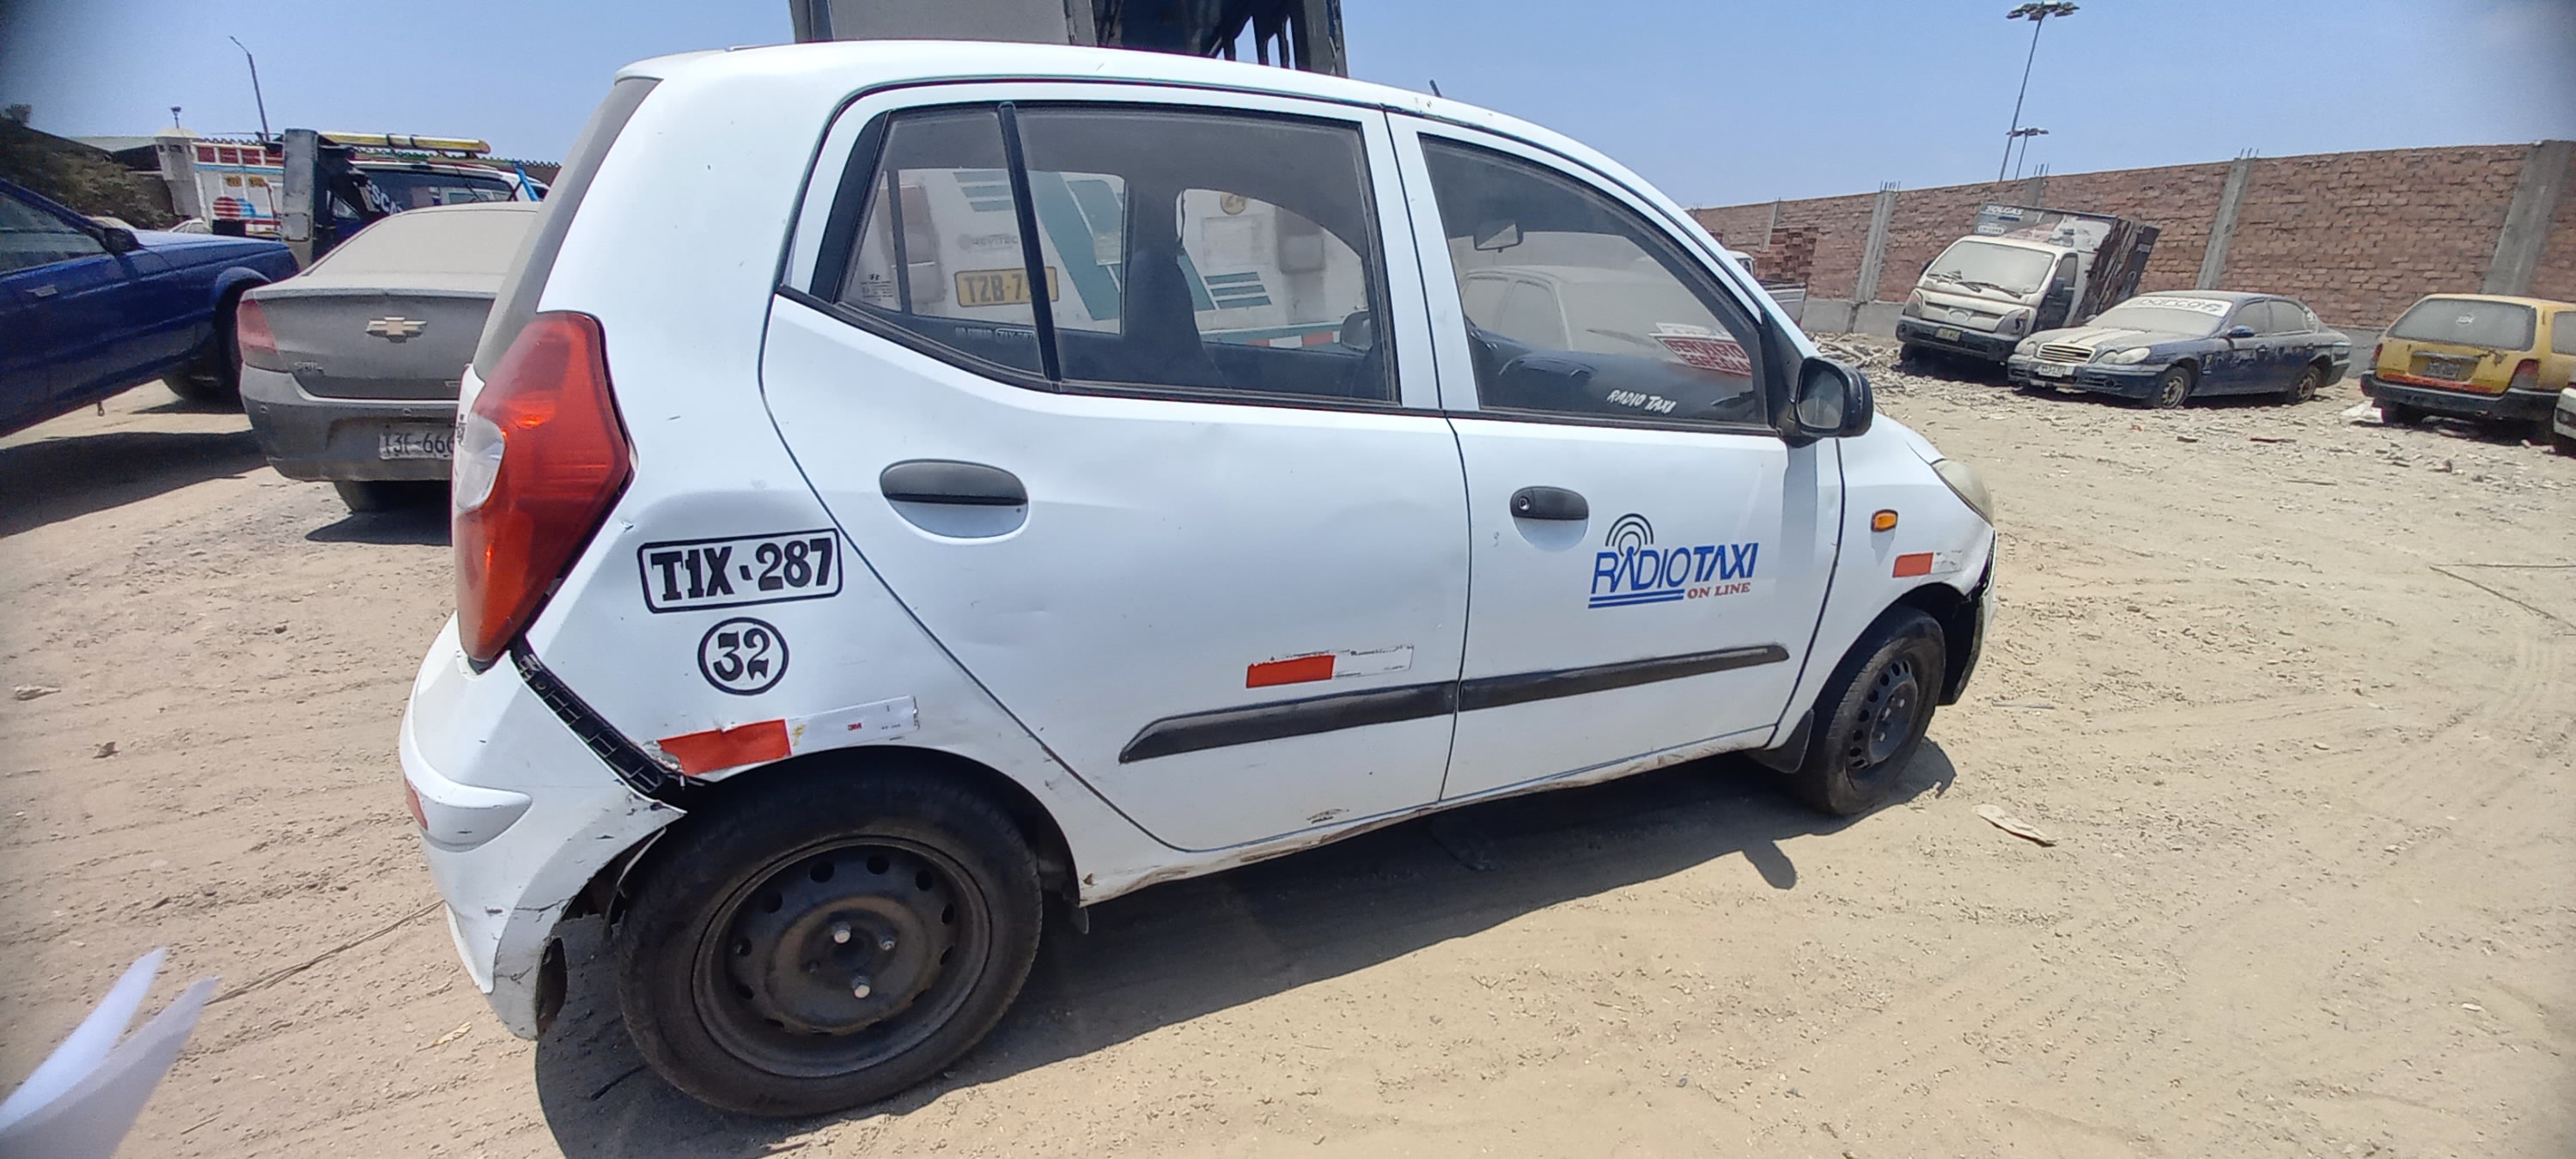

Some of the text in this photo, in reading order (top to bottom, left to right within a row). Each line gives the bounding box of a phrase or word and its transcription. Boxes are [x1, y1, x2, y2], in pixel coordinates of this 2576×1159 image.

[1606, 389, 1678, 414] RADIO TAXI
[1687, 582, 1751, 600] ON LINE
[712, 627, 771, 682] 32
